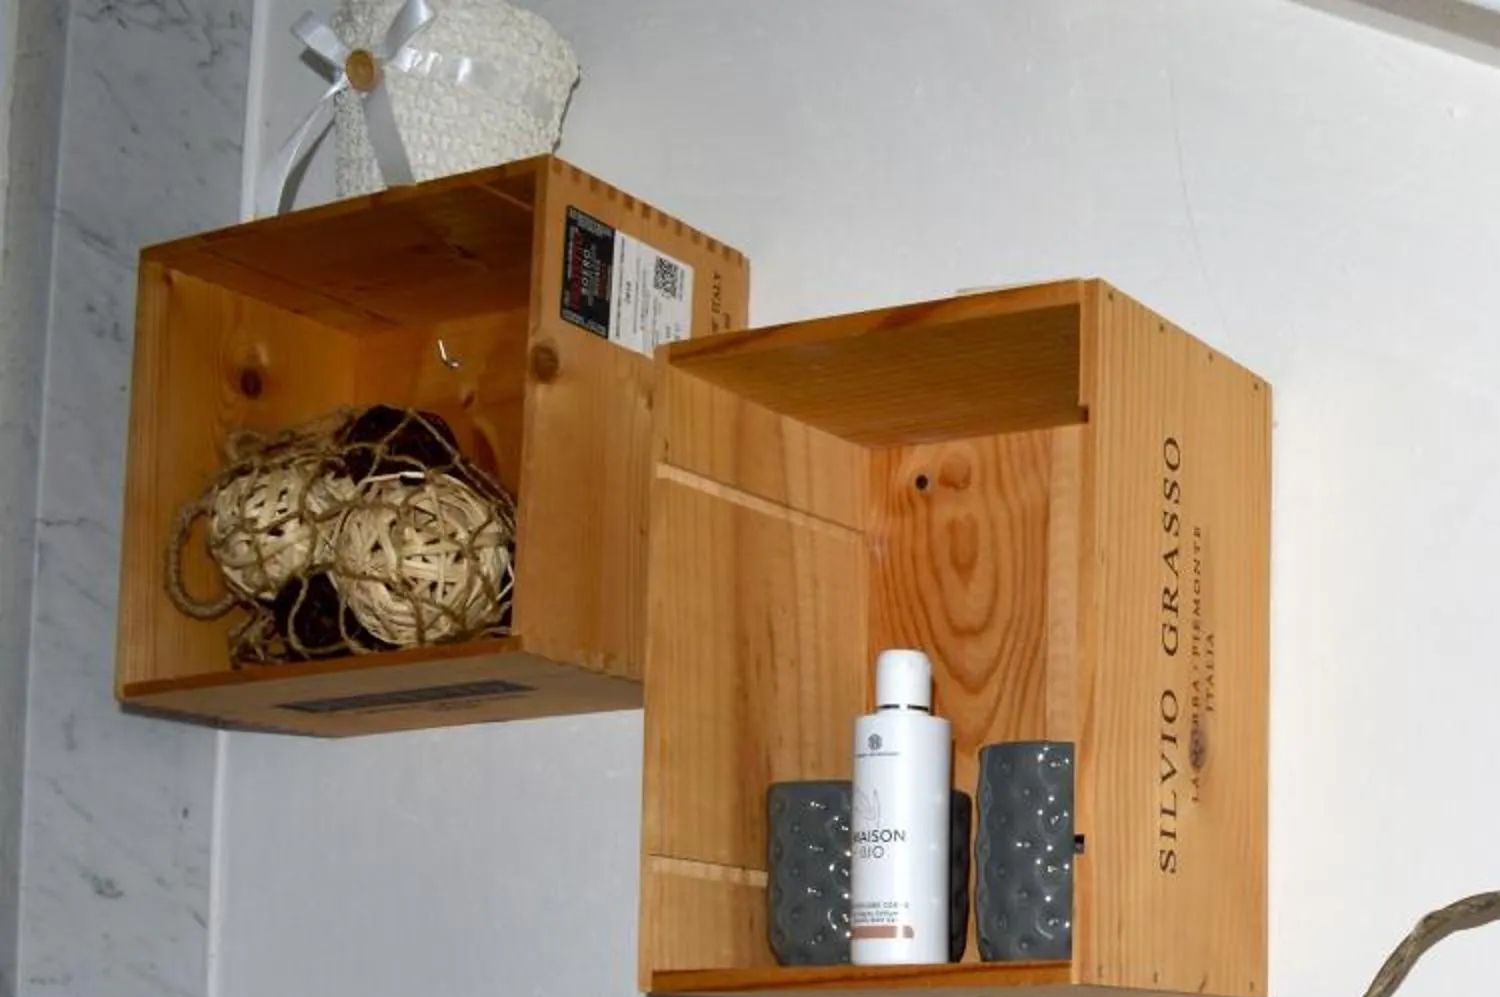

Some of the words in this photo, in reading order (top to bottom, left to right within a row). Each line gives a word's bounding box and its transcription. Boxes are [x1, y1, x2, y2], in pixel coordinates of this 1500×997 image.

[1161, 436, 1182, 657] GRASSO
[1204, 633, 1216, 712] ITALIA
[1159, 688, 1180, 874] SILVIO
